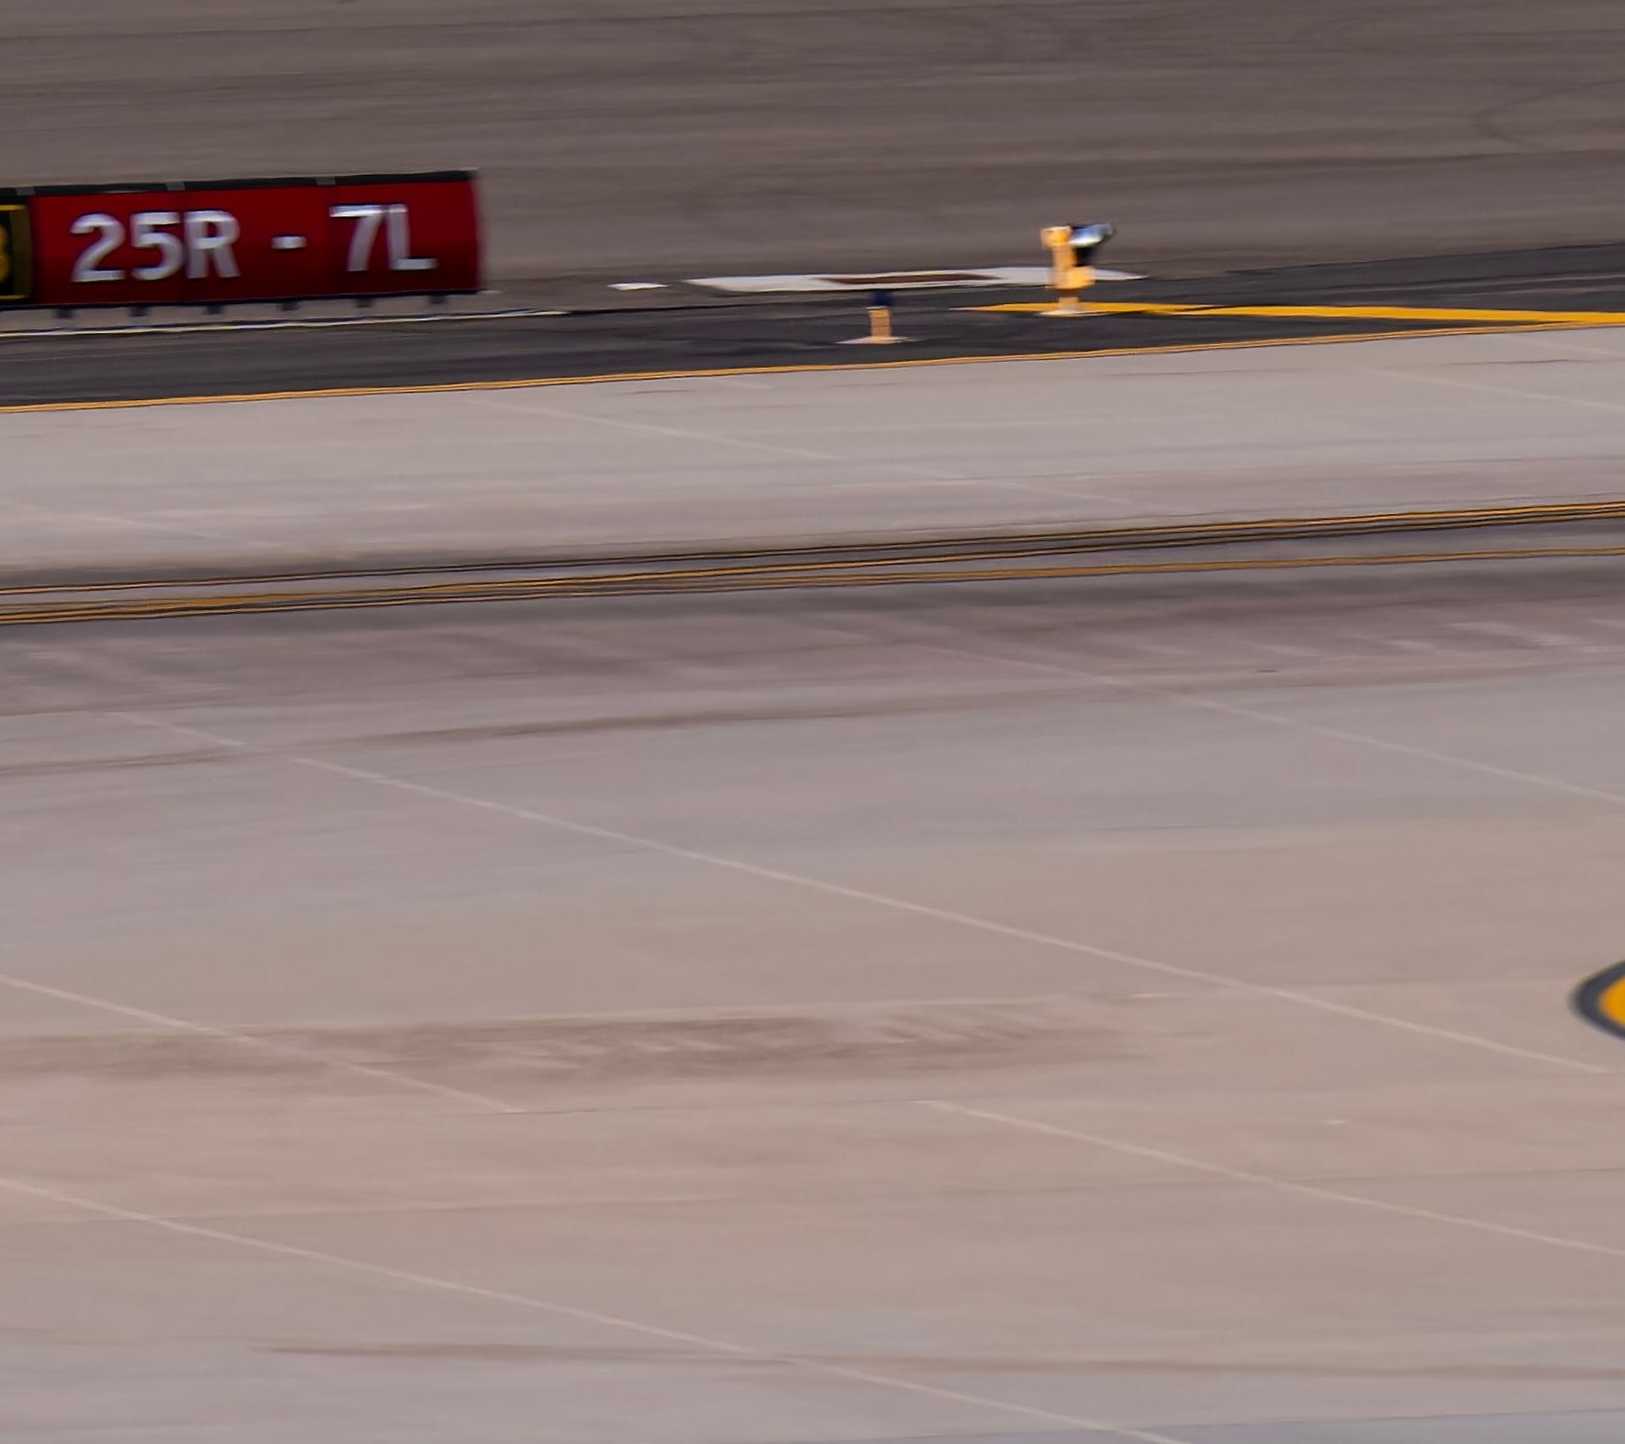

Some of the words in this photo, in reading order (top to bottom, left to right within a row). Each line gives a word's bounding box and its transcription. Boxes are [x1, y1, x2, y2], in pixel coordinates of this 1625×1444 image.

[69, 212, 241, 283] 25R
[272, 235, 307, 250] -
[328, 204, 437, 273] 7L
